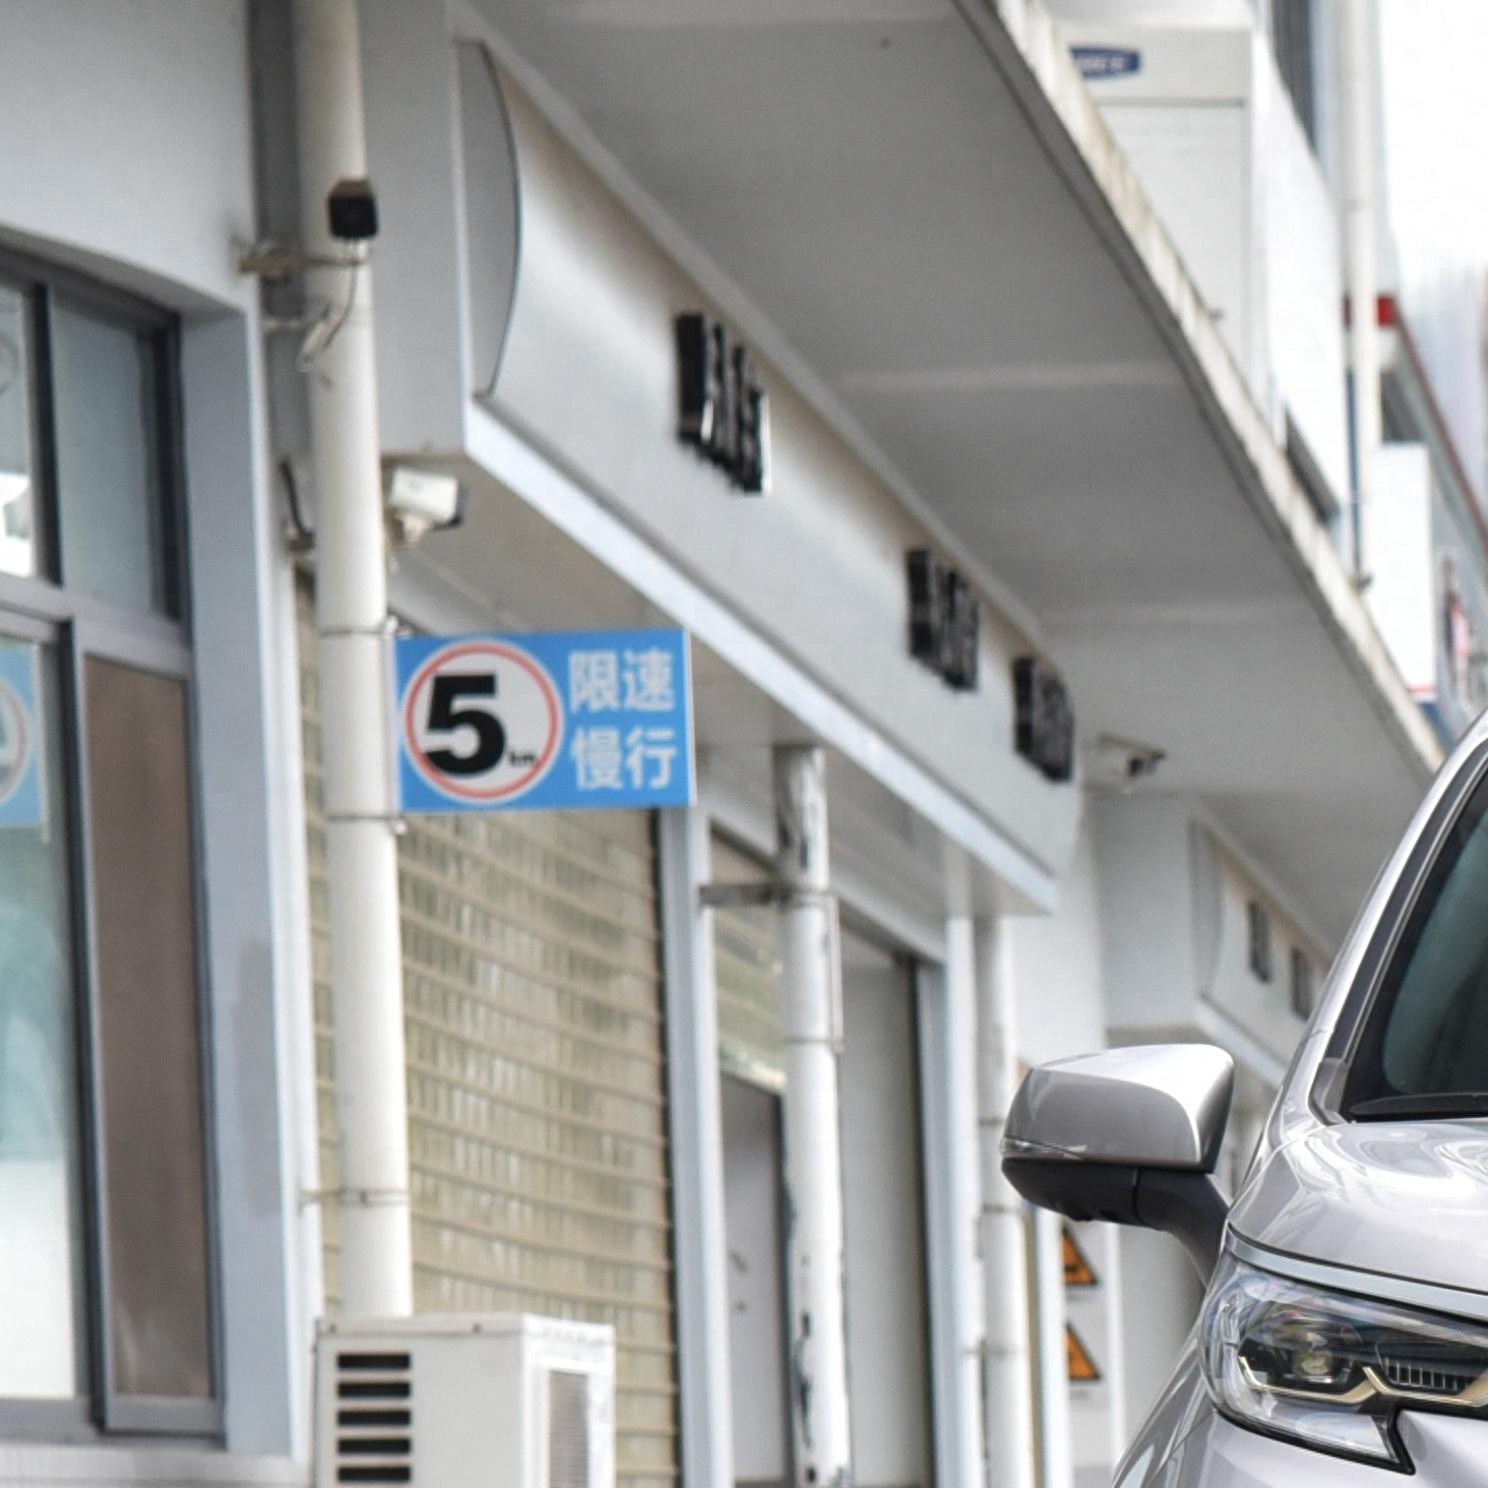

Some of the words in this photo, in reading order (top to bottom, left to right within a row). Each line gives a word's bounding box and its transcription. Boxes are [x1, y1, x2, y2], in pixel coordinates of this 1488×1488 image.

[569, 648, 675, 713] 限速
[424, 673, 506, 777] 5
[571, 726, 677, 790] 慢行
